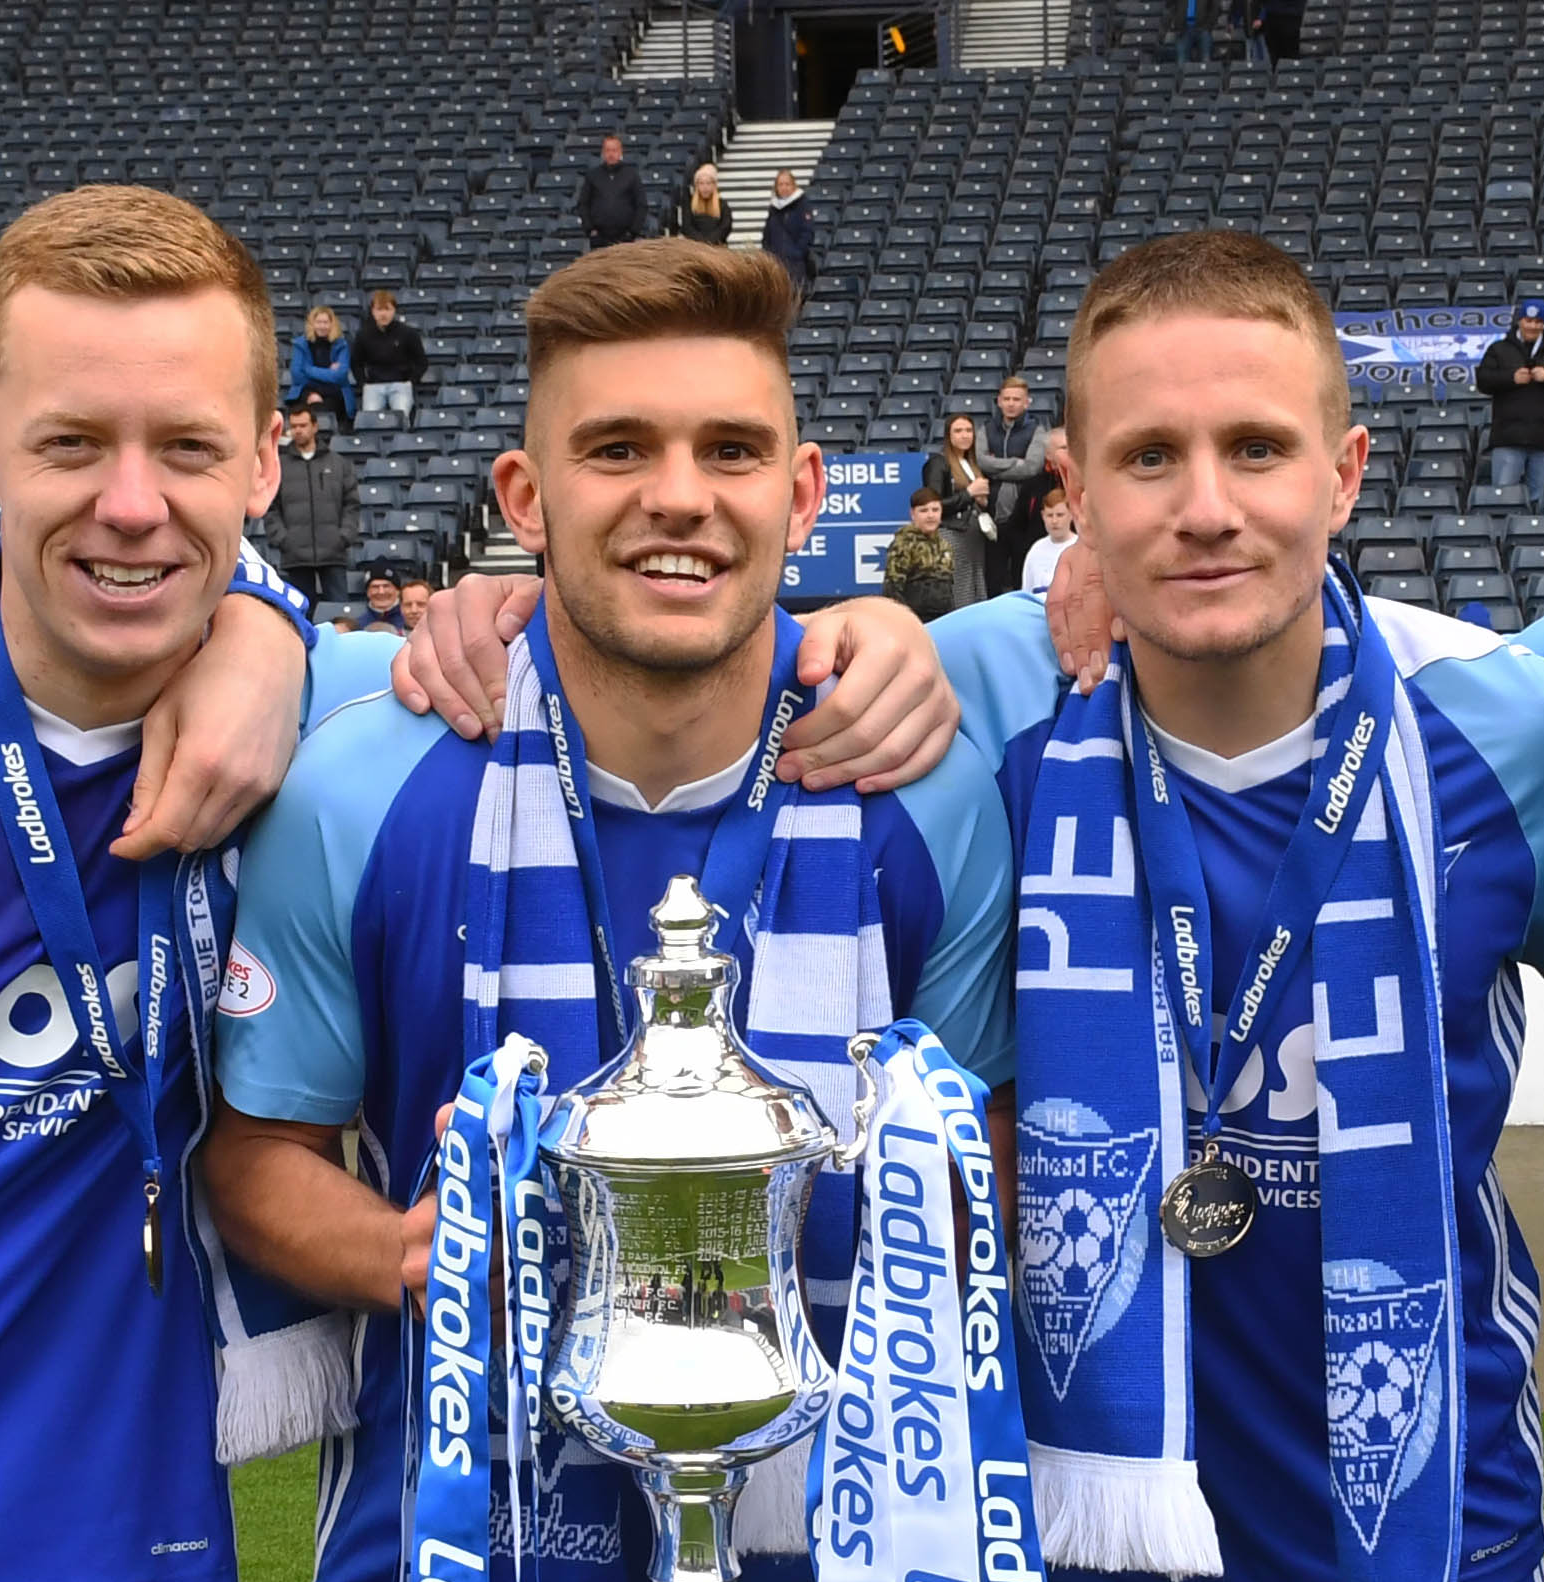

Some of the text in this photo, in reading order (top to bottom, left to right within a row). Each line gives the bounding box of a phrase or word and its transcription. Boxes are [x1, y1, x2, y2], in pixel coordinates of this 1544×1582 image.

[826, 462, 900, 485] SIBLE
[1, 742, 56, 864] Ladbrokes
[546, 692, 585, 820] Ladbrokes
[747, 689, 804, 812] Ladbrokes
[1315, 711, 1376, 835] Ladbrokes
[76, 962, 127, 1080] Ladbrokes
[146, 934, 172, 1060] Ladbrokes
[1170, 904, 1203, 1029] Ladbrokes
[1229, 925, 1292, 1044] Ladbrokes
[912, 1034, 1004, 1392] Ladbrokes
[429, 1093, 488, 1477] Ladbrokes
[515, 1180, 551, 1446] Ladbro
[877, 1122, 958, 1502] Ladbrokes
